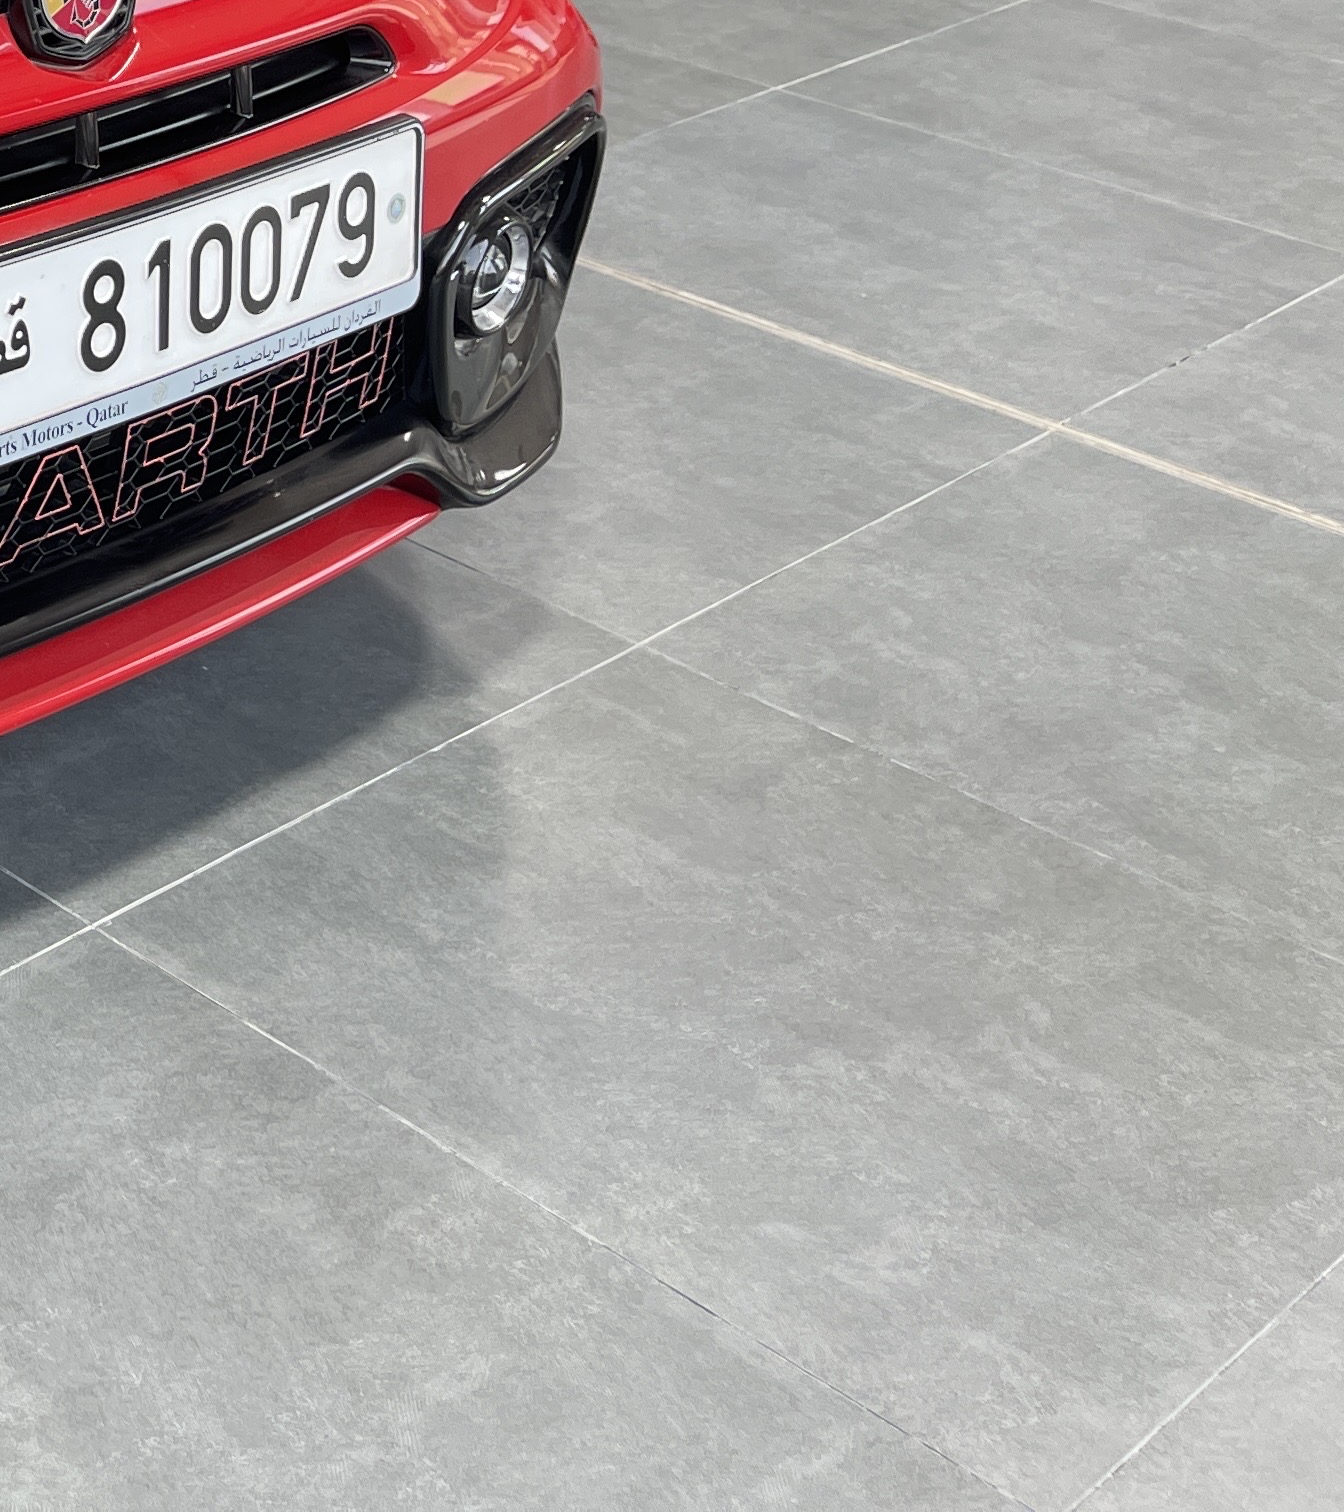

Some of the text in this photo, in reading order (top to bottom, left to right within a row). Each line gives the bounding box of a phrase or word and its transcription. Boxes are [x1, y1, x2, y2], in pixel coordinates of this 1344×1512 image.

[79, 170, 379, 373] 810079
[288, 316, 341, 349] للسيارات
[232, 336, 285, 372] الرياضية
[190, 364, 218, 396] قطر
[21, 419, 75, 451] Motors
[86, 399, 129, 428] Qatar
